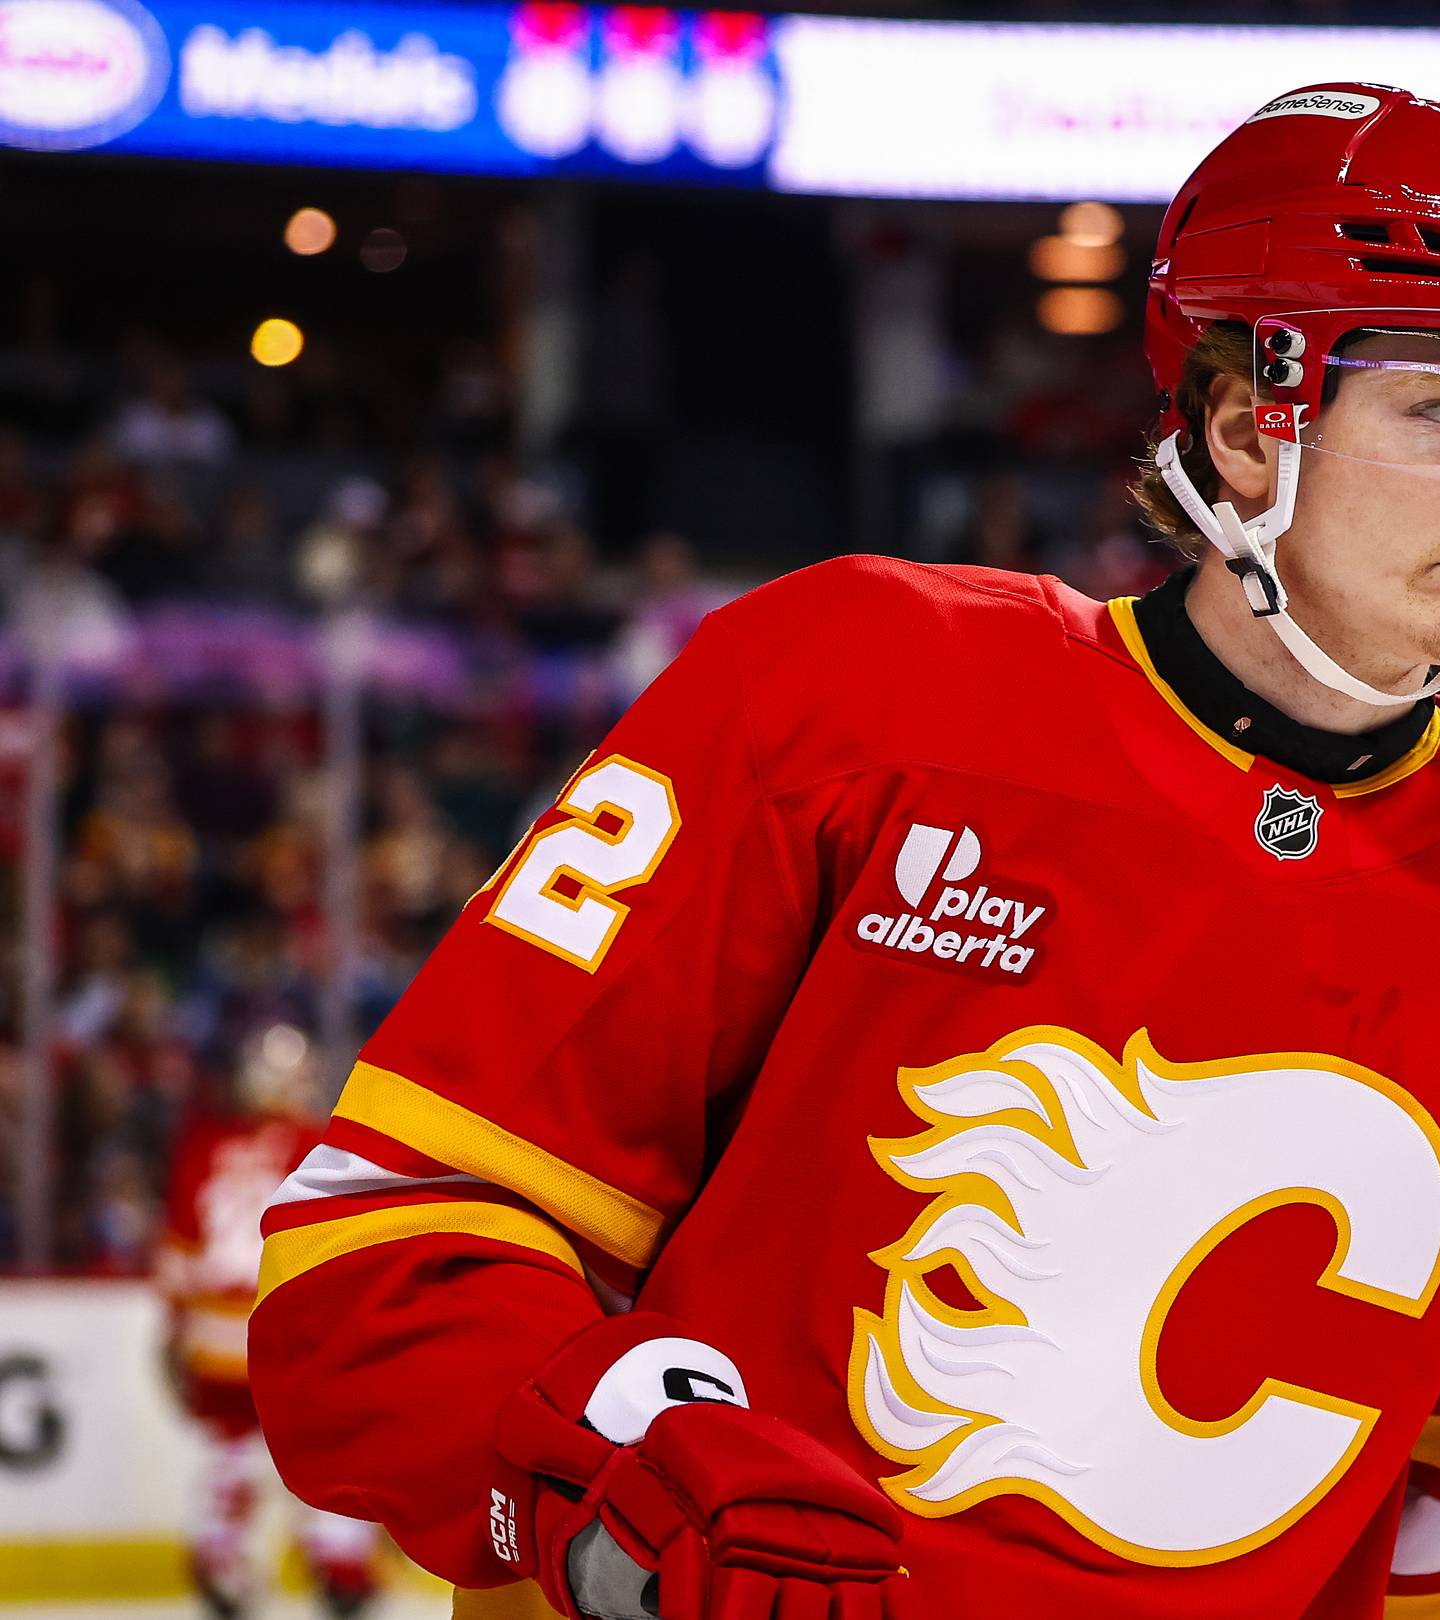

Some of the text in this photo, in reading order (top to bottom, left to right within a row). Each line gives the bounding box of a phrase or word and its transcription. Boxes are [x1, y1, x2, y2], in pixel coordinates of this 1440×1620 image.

[1267, 811, 1309, 840] NHL
[463, 750, 682, 975] 2
[929, 886, 1046, 939] play
[857, 913, 1035, 974] alberta
[490, 1487, 511, 1561] CCM
